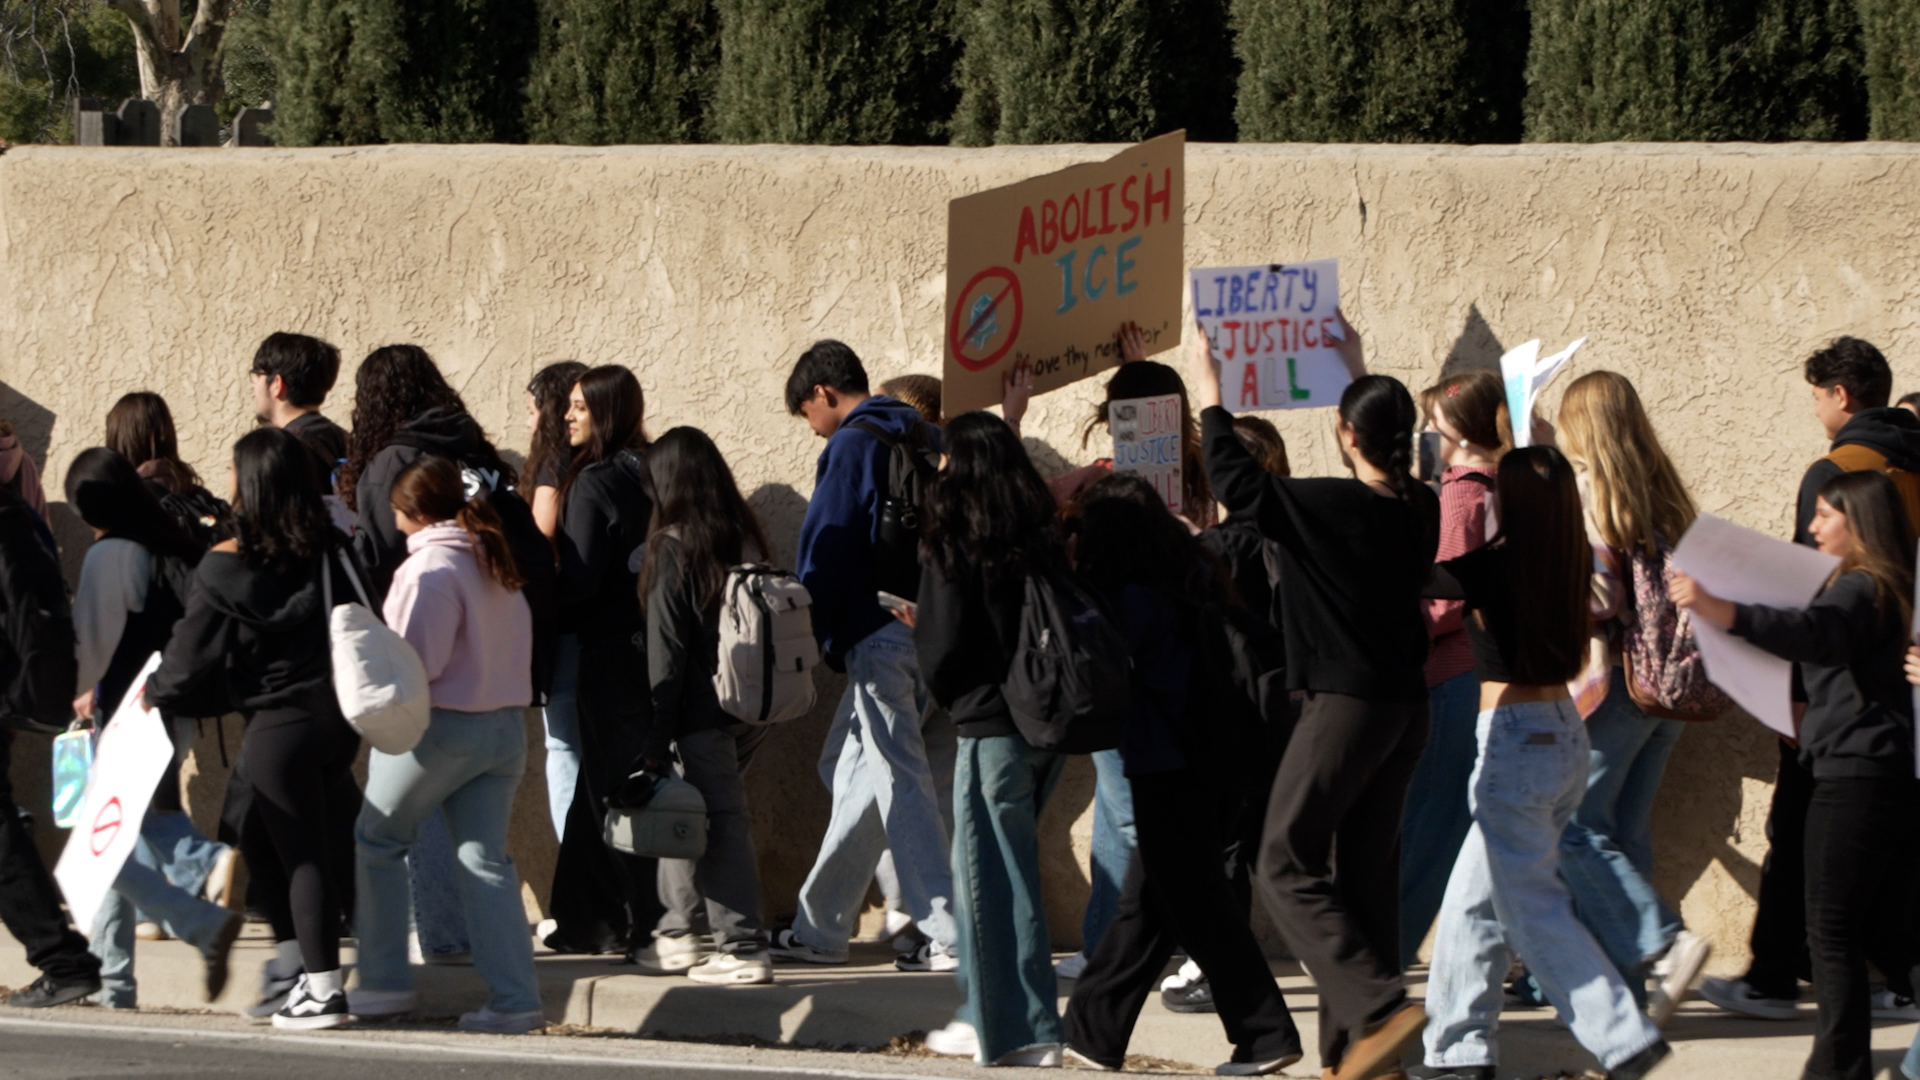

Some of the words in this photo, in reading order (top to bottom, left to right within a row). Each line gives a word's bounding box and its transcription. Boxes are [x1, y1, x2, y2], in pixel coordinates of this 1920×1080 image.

[1013, 167, 1171, 265] ABOLISH
[1054, 235, 1142, 315] ICE
[1193, 268, 1318, 317] LIBERTY
[1064, 344, 1090, 374] thy
[1222, 317, 1334, 360] JUSTICE
[1240, 357, 1310, 407] ALL
[1140, 398, 1178, 435] LIBERTY
[1116, 434, 1179, 466] JUSTICE
